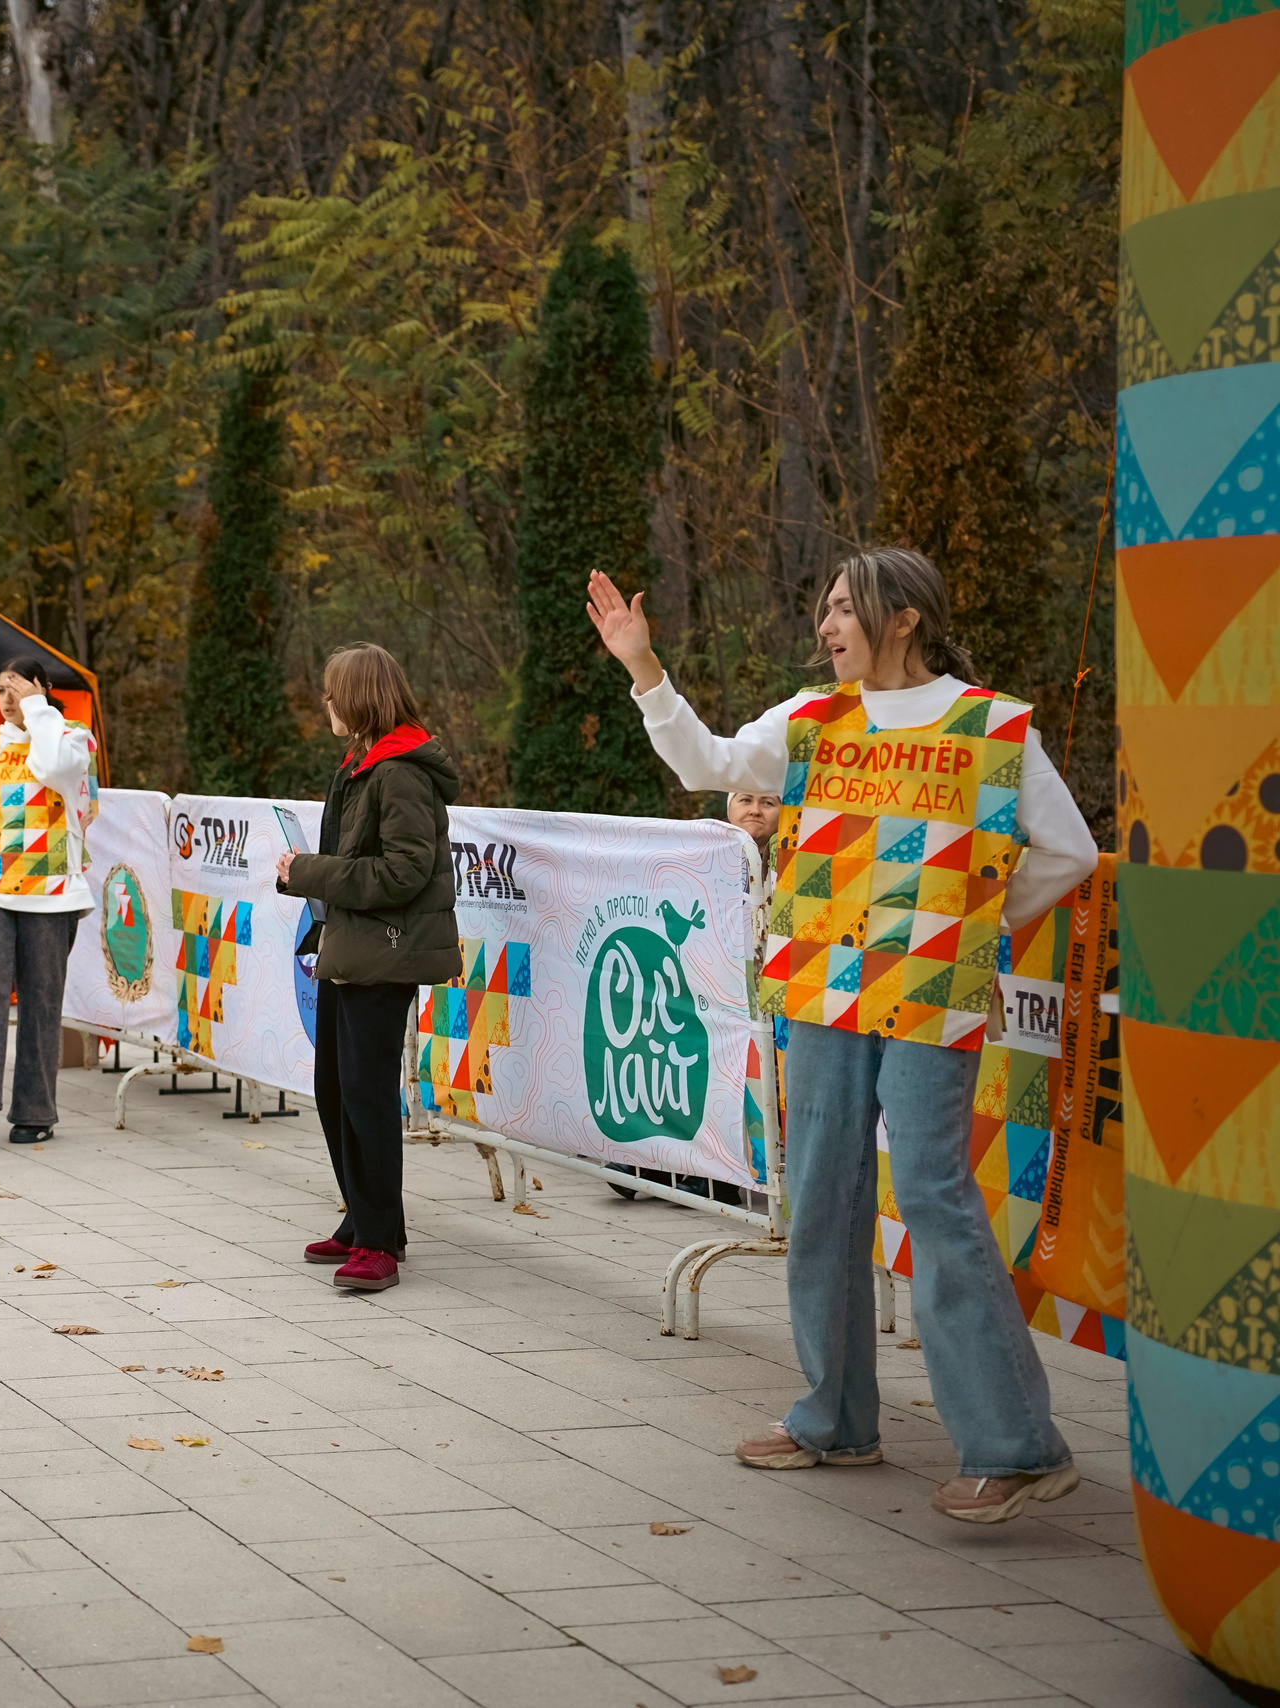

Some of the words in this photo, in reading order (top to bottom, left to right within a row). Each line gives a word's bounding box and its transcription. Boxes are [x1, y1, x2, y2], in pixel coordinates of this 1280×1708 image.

[815, 738, 974, 776] ВОЛОНТЁР
[806, 773, 903, 807] ДОБРЫХ
[912, 782, 965, 815] ДЕЛ
[575, 917, 598, 968] ЛЕГКО
[594, 905, 606, 927] &
[606, 895, 648, 920] ПРОСТО!
[1071, 942, 1086, 982] БЕГИ
[1064, 1021, 1079, 1088] СМОТРИ
[1046, 1126, 1071, 1227] УДИВЛЯЙСЯ
